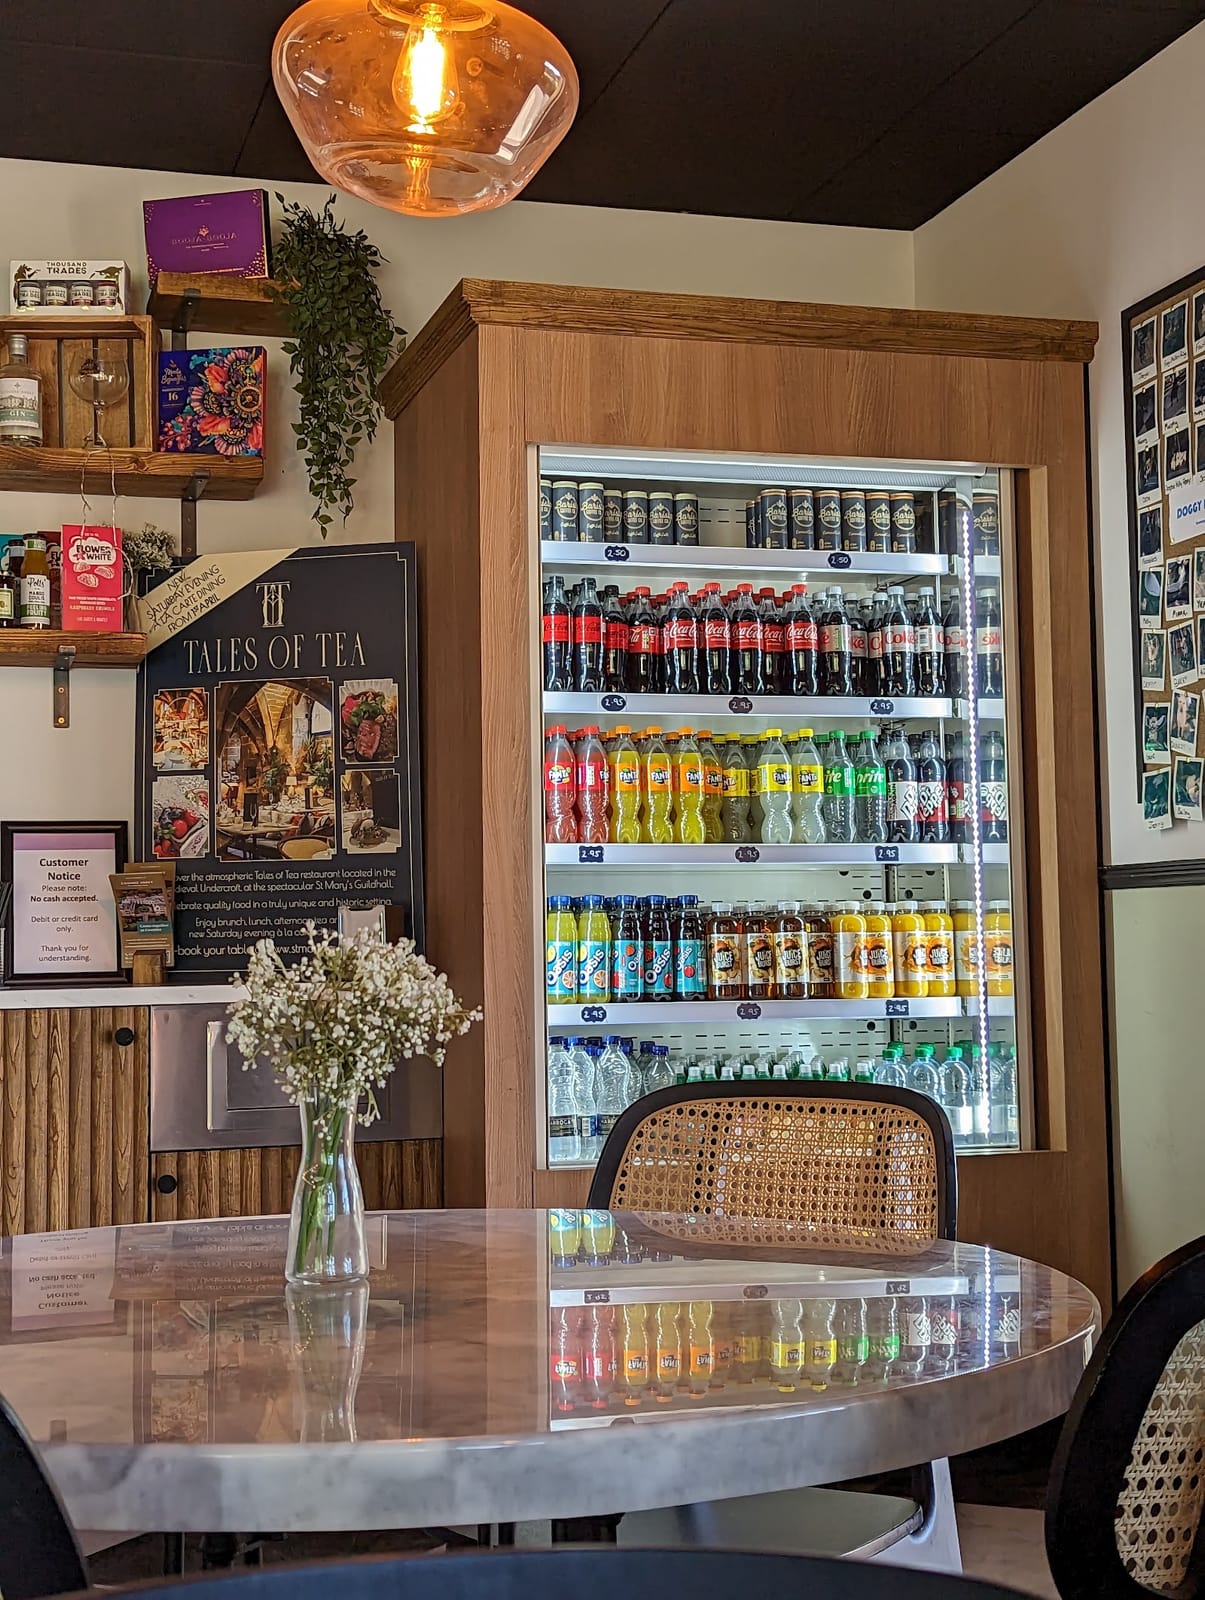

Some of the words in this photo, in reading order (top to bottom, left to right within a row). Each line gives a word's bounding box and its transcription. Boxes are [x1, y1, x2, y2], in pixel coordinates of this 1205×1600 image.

[168, 392, 179, 401] 16
[1176, 500, 1202, 519] DOGGY
[86, 553, 112, 561] WHITE
[146, 587, 185, 620] SATURDAY
[184, 564, 220, 594] EVENING
[172, 593, 198, 616] CARTE
[196, 574, 226, 599] DINING
[167, 611, 193, 633] FROM
[199, 593, 221, 613] APRIL
[183, 637, 258, 674] TALES
[268, 633, 305, 670] OF
[315, 631, 367, 668] TEA
[856, 770, 884, 786] prite
[39, 858, 89, 867] Customer
[47, 871, 81, 881] Notice
[191, 872, 204, 881] the
[205, 871, 253, 882] atmospheric
[254, 870, 274, 880] Tales
[275, 871, 284, 880] of
[285, 869, 299, 879] Tea
[300, 869, 341, 878] restaurant
[341, 867, 373, 878] located
[374, 868, 382, 876] in
[383, 867, 397, 877] the
[42, 884, 66, 892] Please
[243, 883, 252, 891] at
[253, 882, 266, 891] the
[267, 881, 314, 892] spectacular
[315, 880, 323, 890] St
[325, 879, 353, 892] Mary's
[43, 894, 60, 902] cash
[61, 894, 99, 904] accepted.
[203, 900, 231, 911] quality
[232, 899, 252, 909] food
[252, 900, 260, 909] in
[261, 901, 268, 909] a
[268, 899, 288, 910] truly
[288, 899, 317, 909] unique
[317, 897, 335, 907] and
[195, 917, 217, 928] Enjoy
[273, 916, 314, 925] afternoo
[189, 930, 205, 938] new
[206, 928, 243, 939] Saturday
[243, 928, 275, 939] evening
[283, 927, 293, 936] la
[203, 947, 226, 958] your
[227, 943, 248, 954] tabl
[579, 949, 605, 984] Oasis
[645, 948, 671, 984] Oasis
